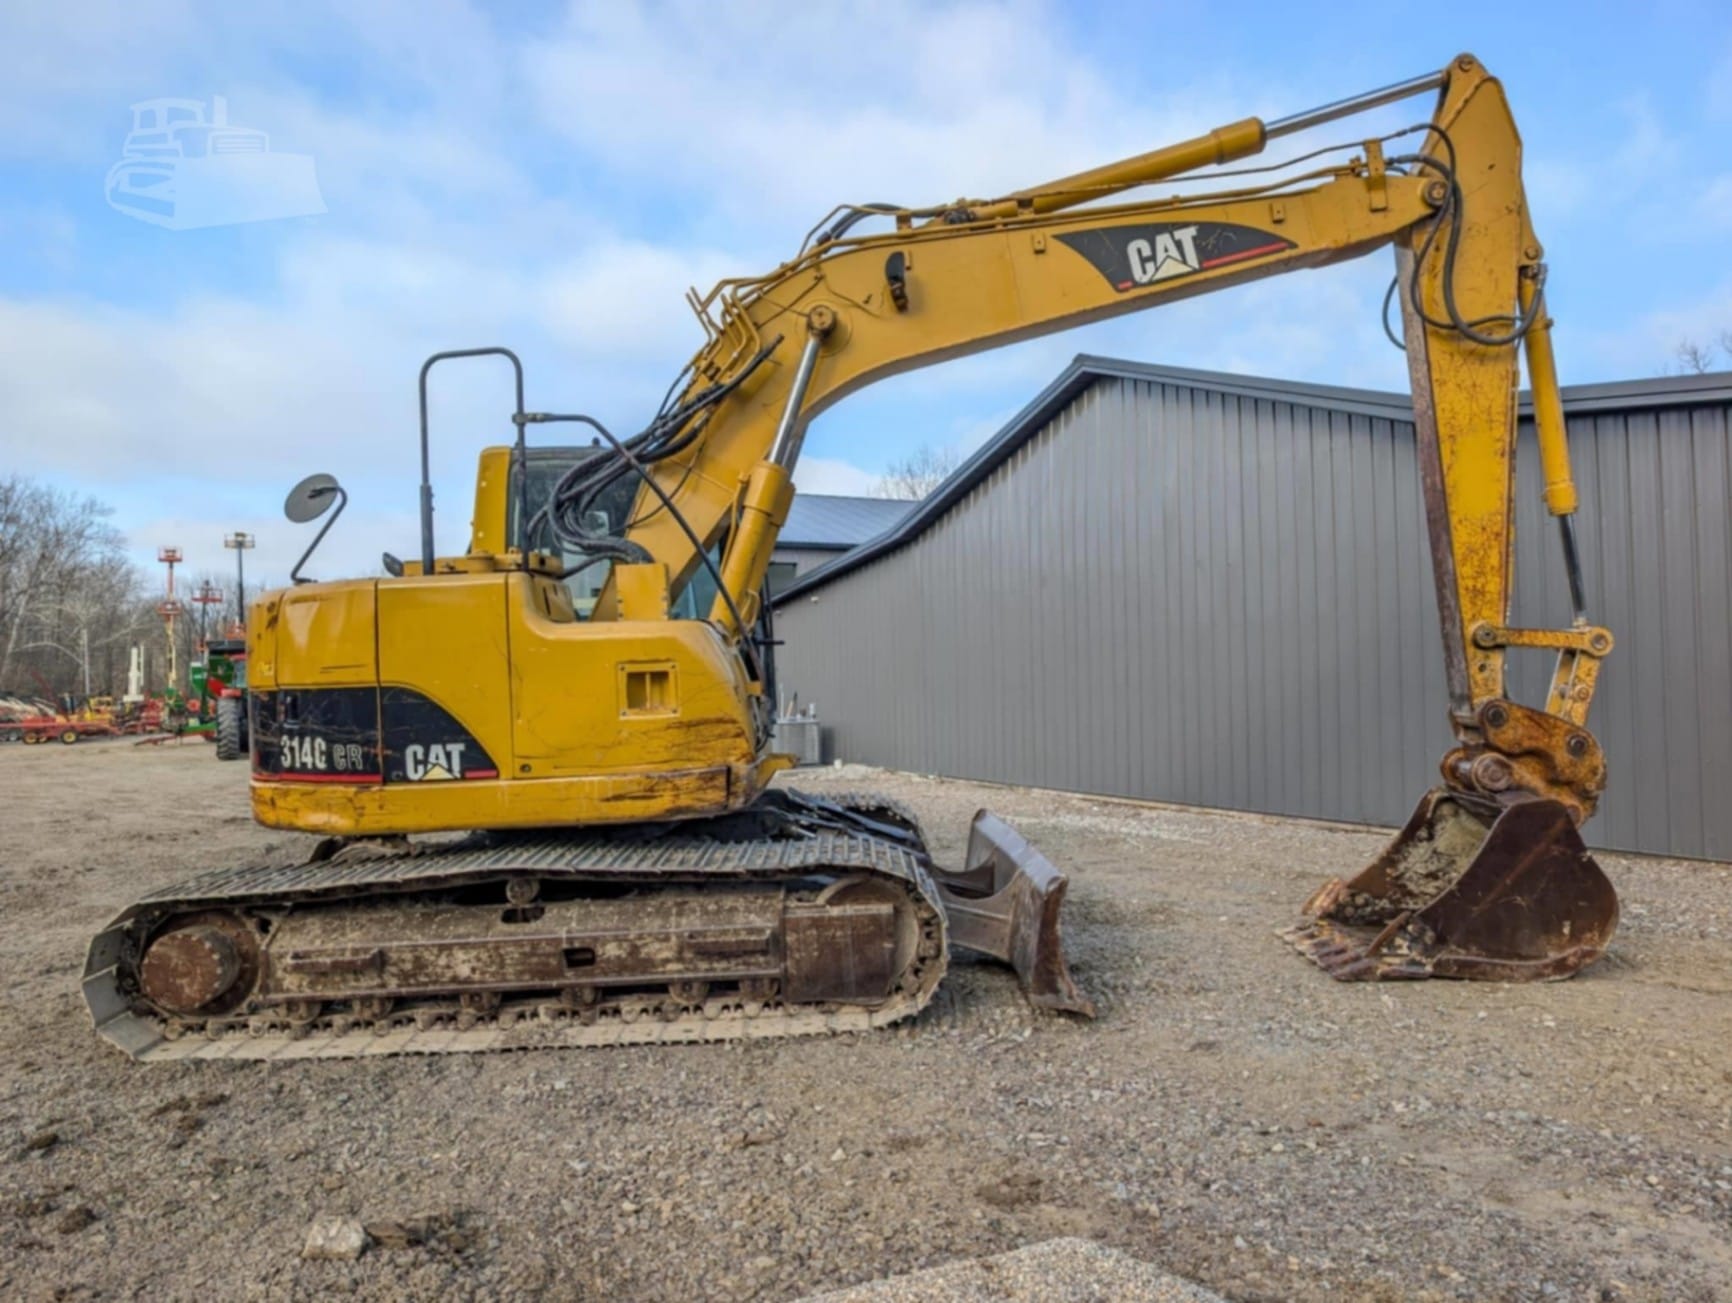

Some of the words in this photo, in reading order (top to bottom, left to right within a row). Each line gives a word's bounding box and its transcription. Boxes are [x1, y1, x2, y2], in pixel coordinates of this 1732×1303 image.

[1127, 226, 1199, 284] CAT
[280, 735, 327, 769] 314C
[405, 742, 466, 781] CAT
